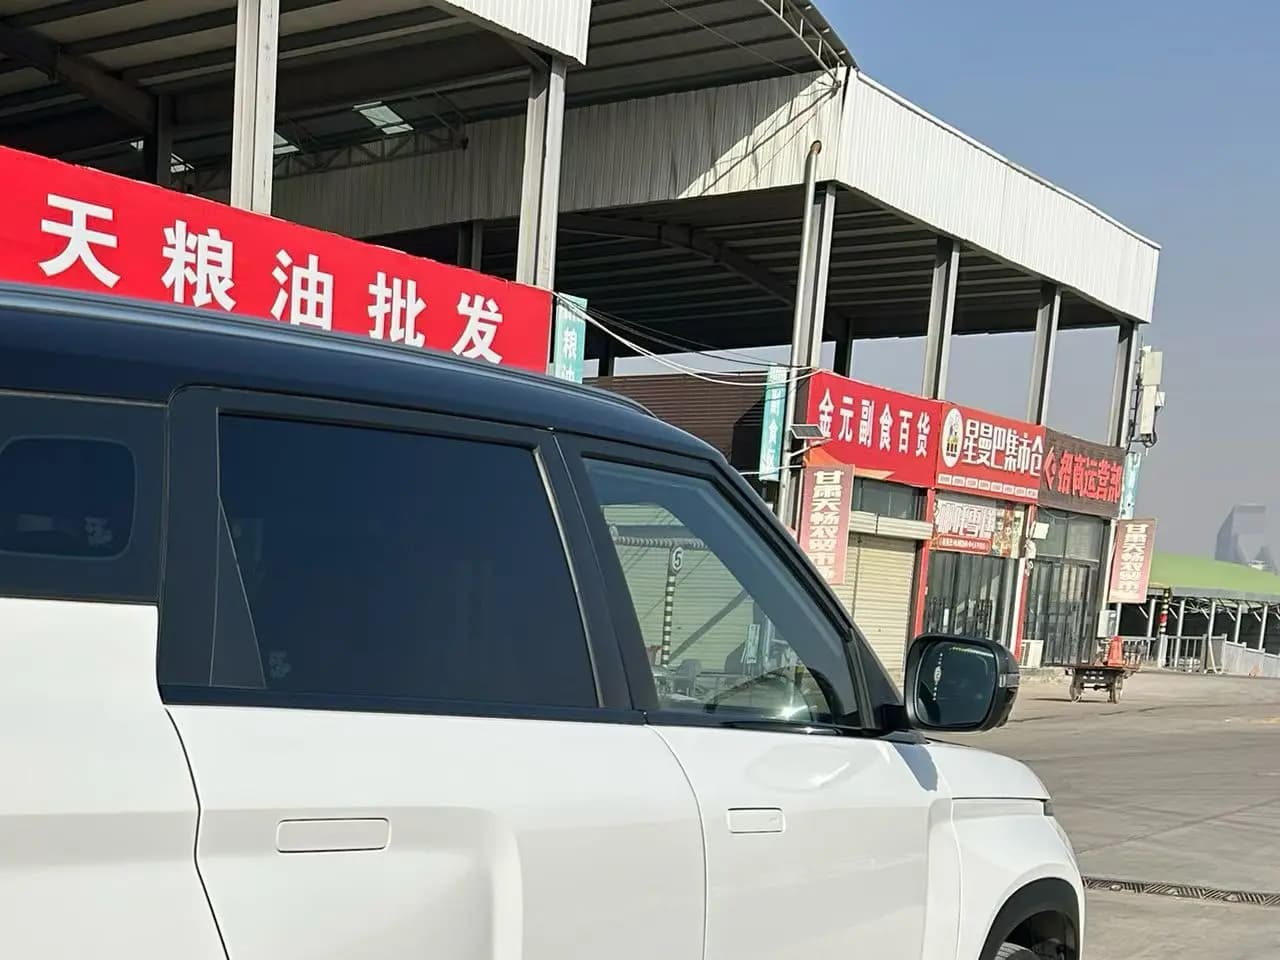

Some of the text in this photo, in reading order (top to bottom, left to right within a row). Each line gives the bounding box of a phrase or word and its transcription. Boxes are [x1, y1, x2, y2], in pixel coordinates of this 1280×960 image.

[818, 387, 931, 458] 金元副食百货
